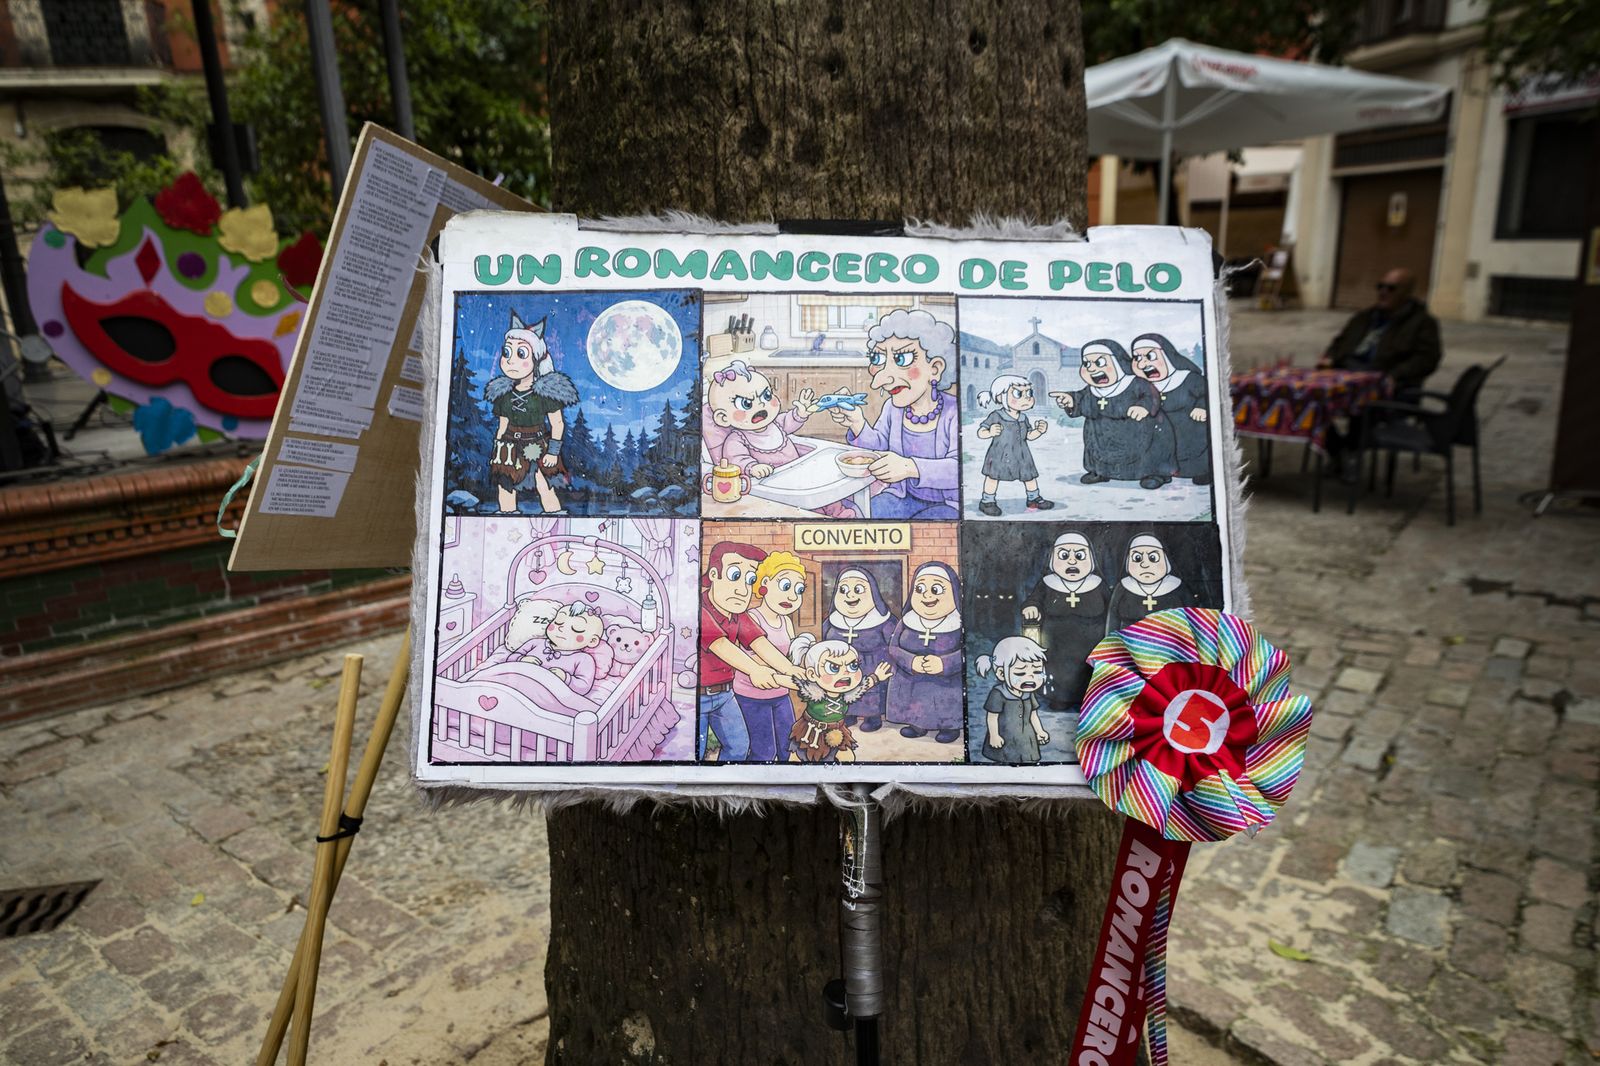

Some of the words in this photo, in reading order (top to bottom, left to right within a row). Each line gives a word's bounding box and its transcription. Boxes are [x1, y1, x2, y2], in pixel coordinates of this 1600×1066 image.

[475, 254, 564, 288] UN
[573, 246, 942, 287] ROMANCERO
[959, 258, 1030, 293] DE
[1048, 260, 1184, 296] PELO
[800, 527, 903, 546] CONVENTO
